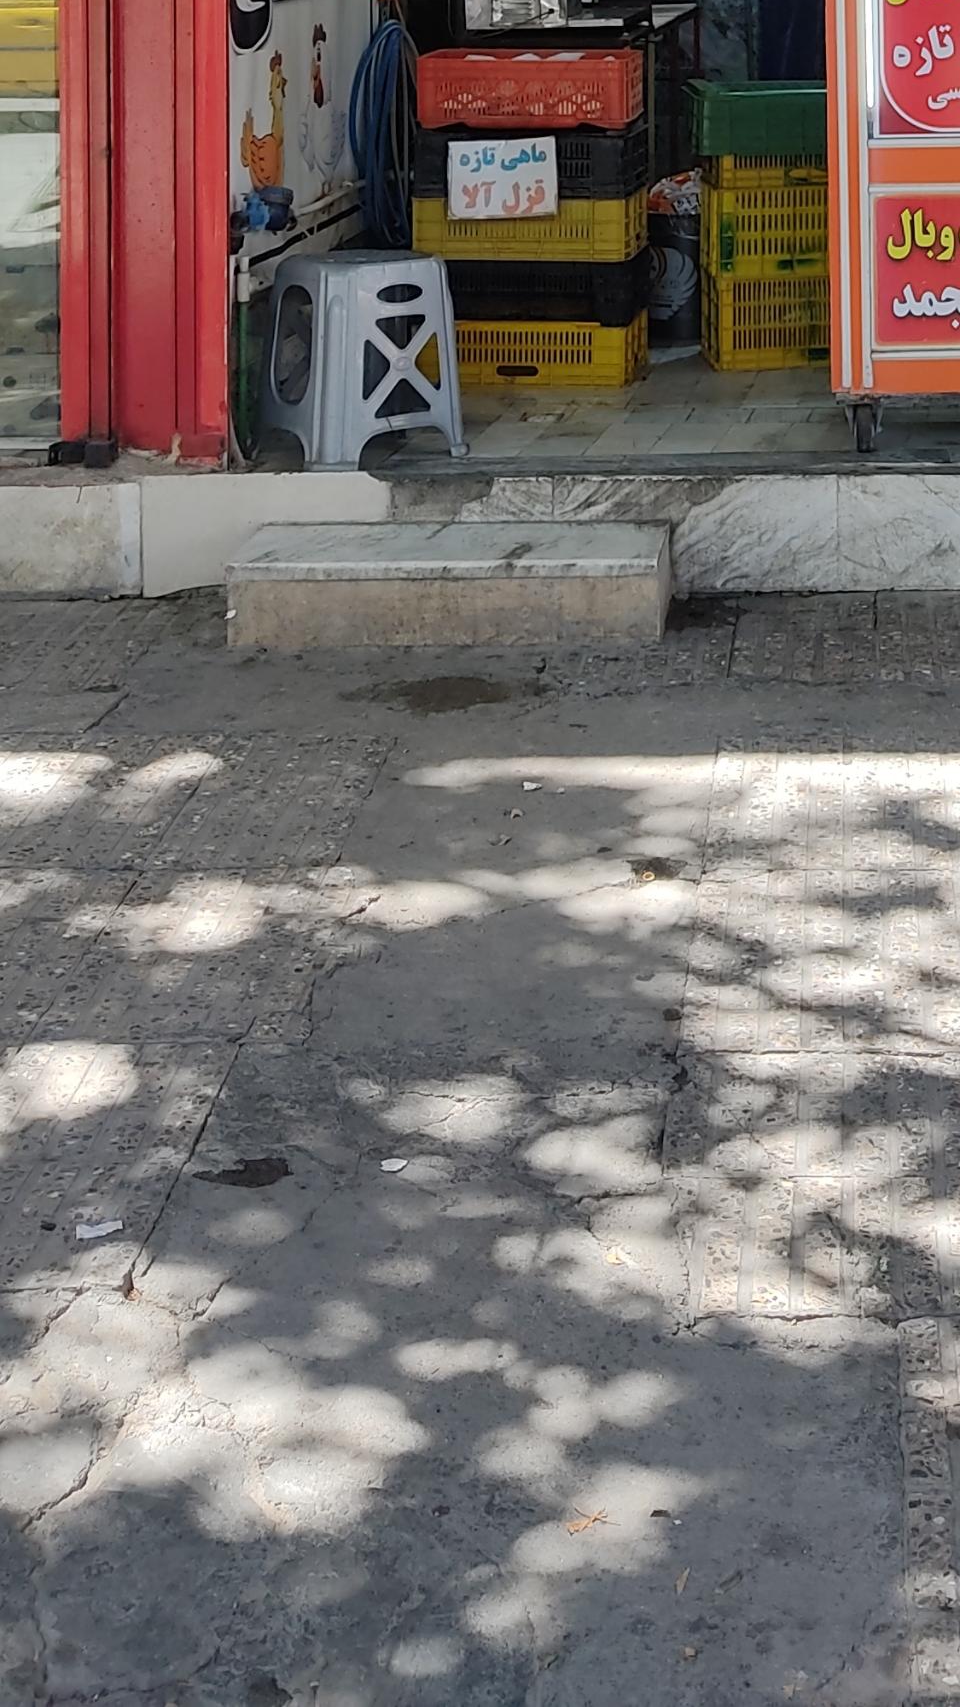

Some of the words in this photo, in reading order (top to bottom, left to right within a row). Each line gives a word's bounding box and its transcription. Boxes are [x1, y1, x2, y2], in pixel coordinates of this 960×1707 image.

[891, 29, 957, 77] تازه
[459, 145, 497, 173] تازه
[500, 142, 547, 171] ماهی
[461, 180, 496, 209] آلا
[501, 178, 546, 215] قزل
